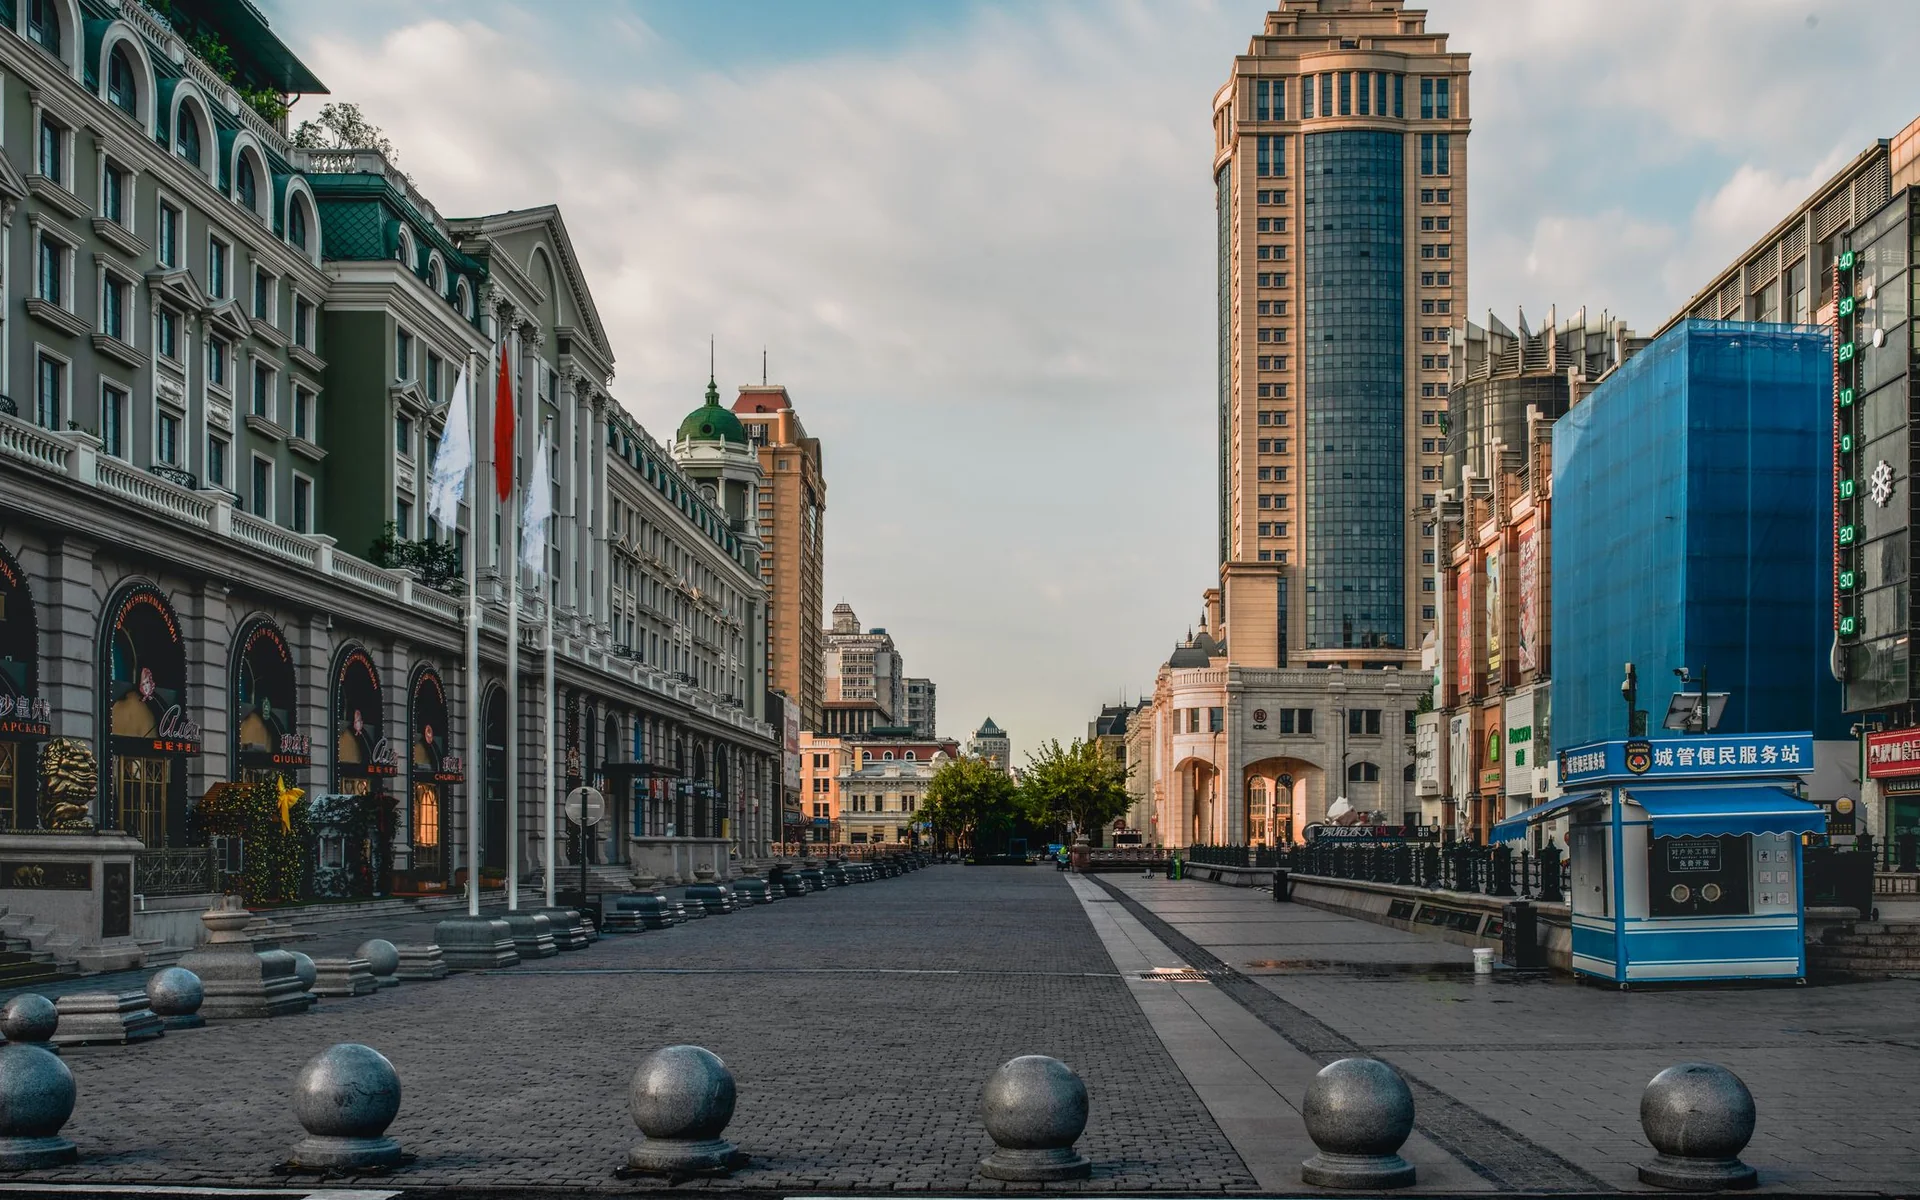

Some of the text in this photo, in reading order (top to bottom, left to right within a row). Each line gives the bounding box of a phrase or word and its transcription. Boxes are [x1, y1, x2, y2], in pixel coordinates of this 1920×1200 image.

[1839, 251, 1854, 269] 40
[1839, 298, 1854, 316] 30
[1839, 344, 1854, 361] 20
[1840, 389, 1854, 406] 10
[1843, 435, 1852, 452] 0
[1840, 480, 1854, 497] 10
[1839, 526, 1854, 543] 20
[1839, 572, 1854, 589] 30
[1839, 617, 1854, 633] 40
[272, 754, 303, 765] QIULIN
[1568, 751, 1605, 774] 城管便民服务站
[1654, 744, 1800, 767] 城管便民服务站
[1671, 848, 1717, 856] 对户外工作者
[1679, 859, 1710, 867] 免费开放
